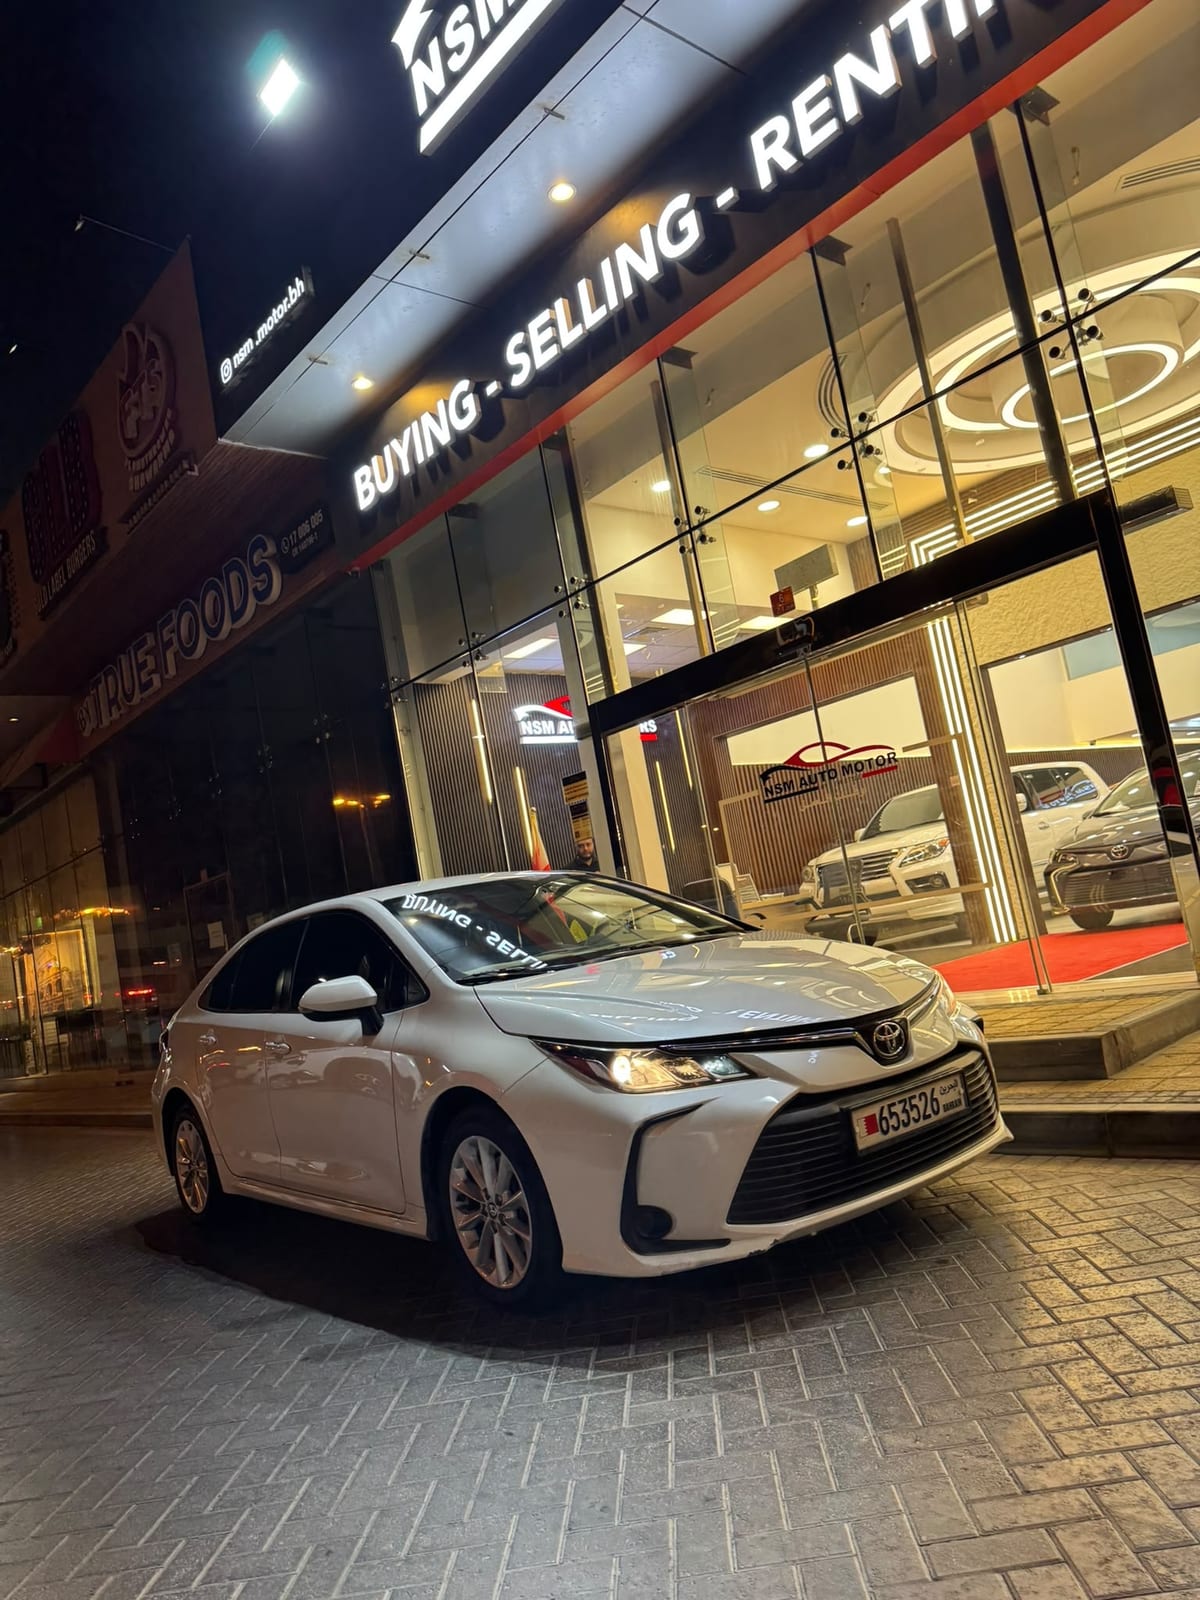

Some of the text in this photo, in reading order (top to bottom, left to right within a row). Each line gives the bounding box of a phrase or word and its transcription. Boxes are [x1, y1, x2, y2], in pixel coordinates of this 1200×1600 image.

[354, 379, 479, 511] BUYING
[506, 192, 703, 388] SELLING
[750, 0, 996, 191] RENTI
[233, 337, 254, 369] nsm
[89, 631, 162, 730] TRUE
[157, 533, 283, 681] FOODS
[521, 719, 556, 736] NSM
[764, 751, 898, 798] NSM AUTO MOTOR
[879, 1087, 940, 1136] 653526
